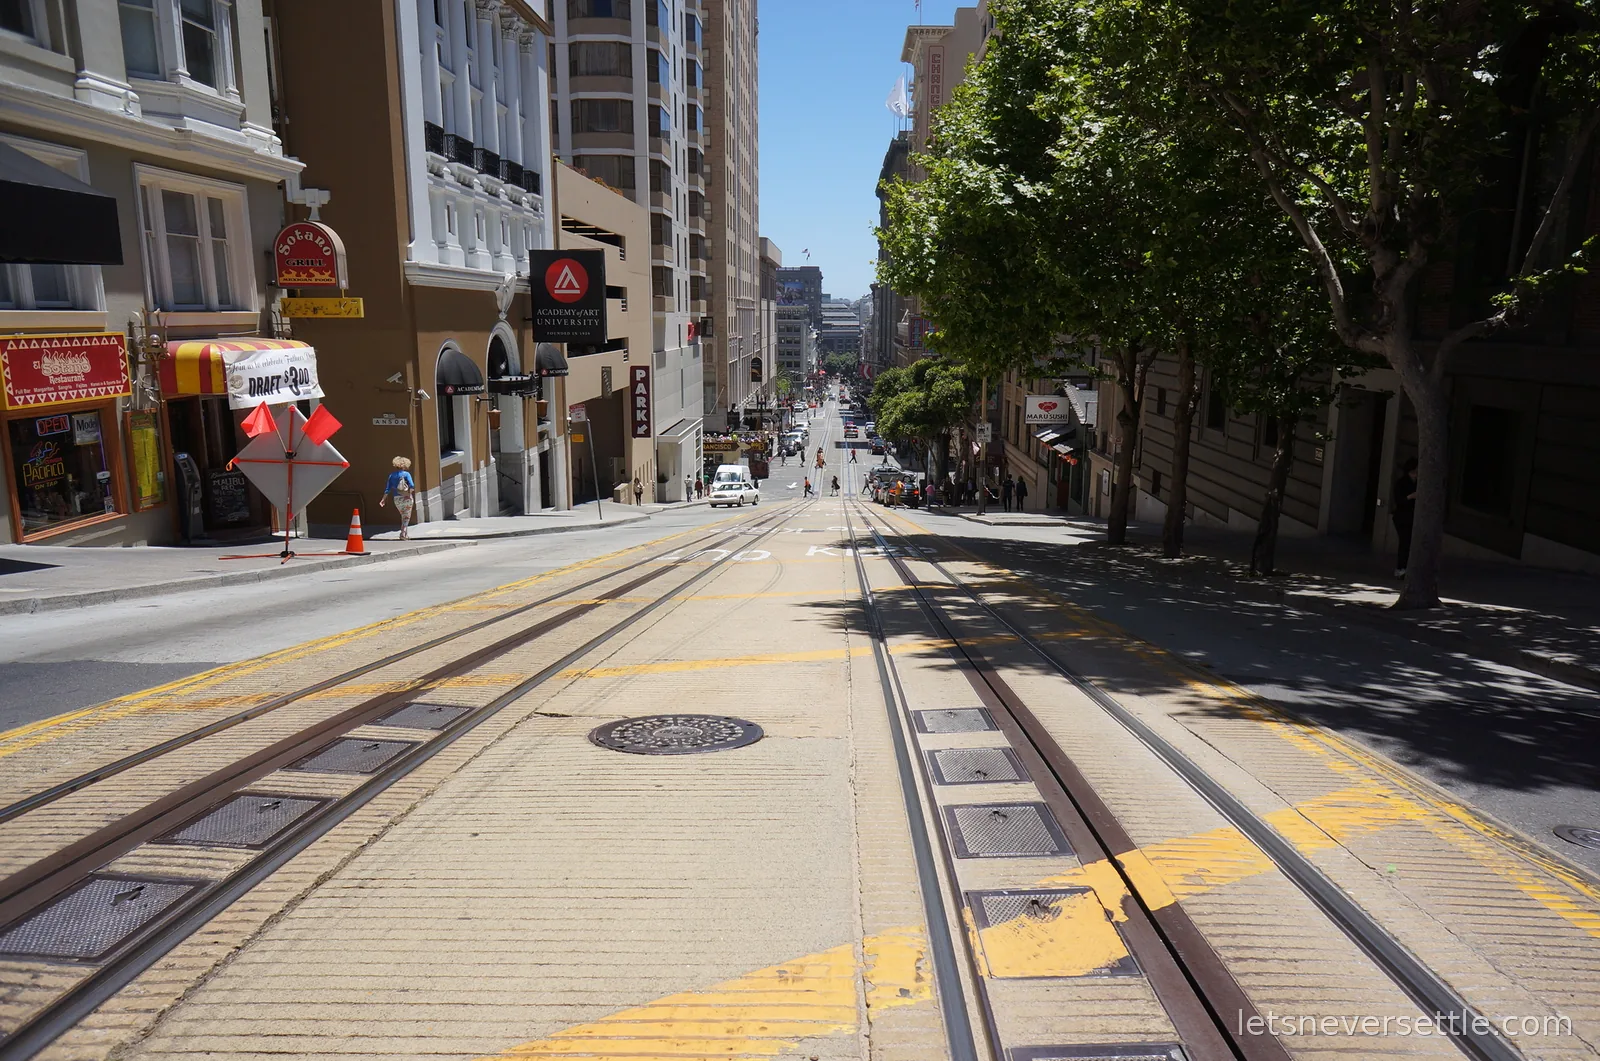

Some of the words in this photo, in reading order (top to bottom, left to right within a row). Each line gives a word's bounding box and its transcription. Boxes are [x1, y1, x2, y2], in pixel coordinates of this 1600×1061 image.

[278, 229, 332, 256] Sotano
[285, 258, 325, 267] GRILL
[536, 308, 576, 316] ACADEMY
[575, 308, 584, 317] of
[583, 308, 600, 316] ART
[536, 318, 600, 326] UNIVERSITY
[32, 361, 41, 370] El
[41, 355, 91, 377] Sotano
[229, 360, 247, 374] Join
[261, 357, 284, 368] celebrate
[48, 373, 86, 385] Restaurant
[248, 374, 282, 398] DRAFT
[634, 369, 648, 421] PARK
[37, 417, 69, 435] OPEN
[23, 462, 65, 486] PACIFICO
[212, 477, 246, 486] MALIBU
[34, 483, 45, 491] ON
[46, 480, 58, 488] TAP
